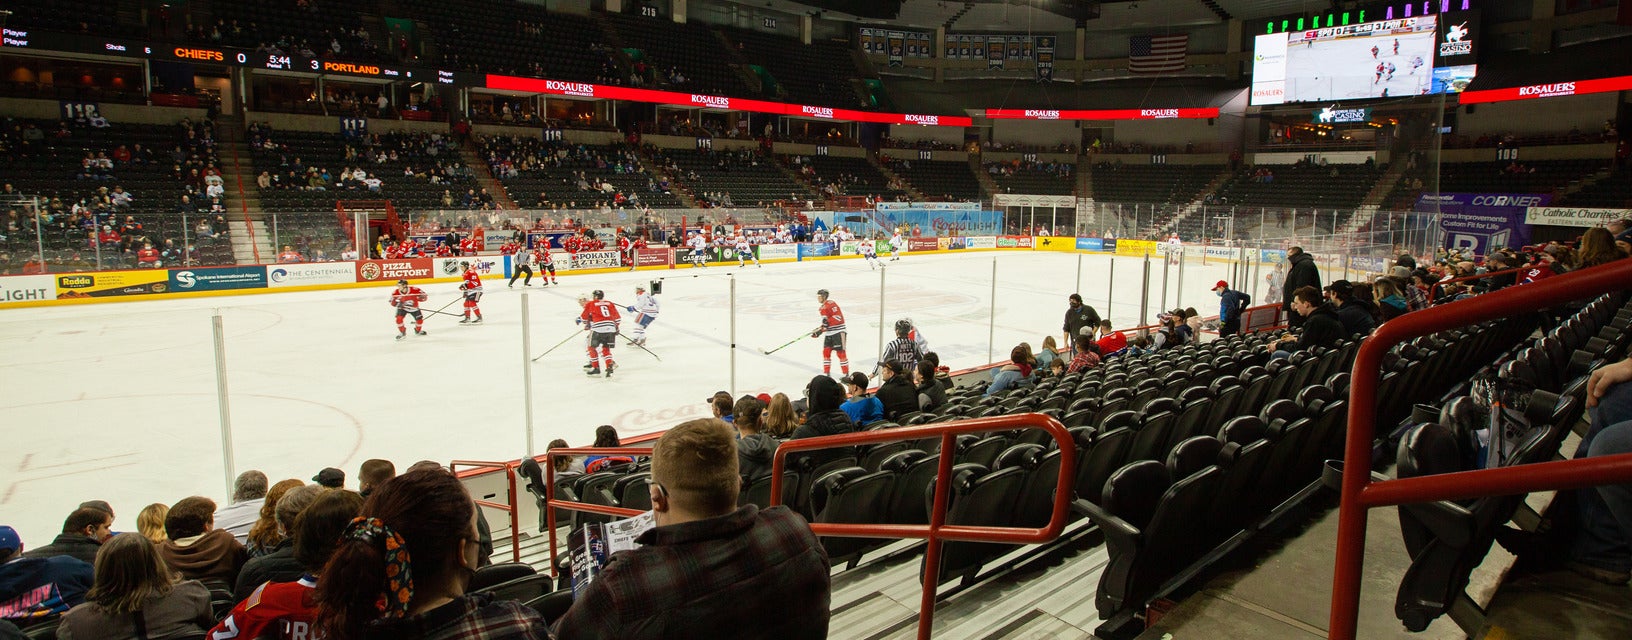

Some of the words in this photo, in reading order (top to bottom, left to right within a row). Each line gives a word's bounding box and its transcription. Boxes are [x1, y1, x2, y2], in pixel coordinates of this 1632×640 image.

[641, 6, 656, 17] 215
[1267, 10, 1366, 34] SPOKANE
[1386, 0, 1470, 20] ARENA
[764, 18, 776, 28] 214
[2, 28, 28, 38] Player
[3, 37, 28, 46] Player
[106, 43, 126, 52] Shots
[1440, 44, 1472, 52] CASINO
[174, 48, 224, 62] CHIEFS
[237, 54, 246, 64] 0
[269, 55, 291, 64] 5:44
[310, 60, 319, 70] 3
[324, 62, 380, 75] PORTLAND
[546, 80, 594, 92] ROSAUERS
[1519, 82, 1576, 96] ROSAUERS
[1253, 88, 1284, 98] ROSAUERS
[692, 94, 729, 105] ROSAUERS
[802, 106, 834, 115] ROSAUERS
[1141, 108, 1178, 117] ROSAUERS
[905, 114, 938, 122] ROSAUERS
[344, 118, 365, 130] 117
[698, 138, 711, 149] 115
[816, 147, 828, 155] 114
[920, 151, 931, 160] 113
[1498, 148, 1518, 160] 109
[1024, 154, 1036, 162] 112
[1152, 155, 1166, 163] 111
[1472, 196, 1542, 207] CORNER
[1458, 213, 1508, 222] Improvements
[1543, 208, 1576, 218] Catholic
[1578, 209, 1620, 218] Charities
[968, 221, 998, 231] LIGHT
[576, 252, 616, 260] SPOKANE
[572, 257, 619, 268] AZTECA
[382, 269, 428, 278] FACTORY
[62, 278, 90, 286] Rodda
[600, 305, 610, 318] 6
[899, 352, 914, 362] 102
